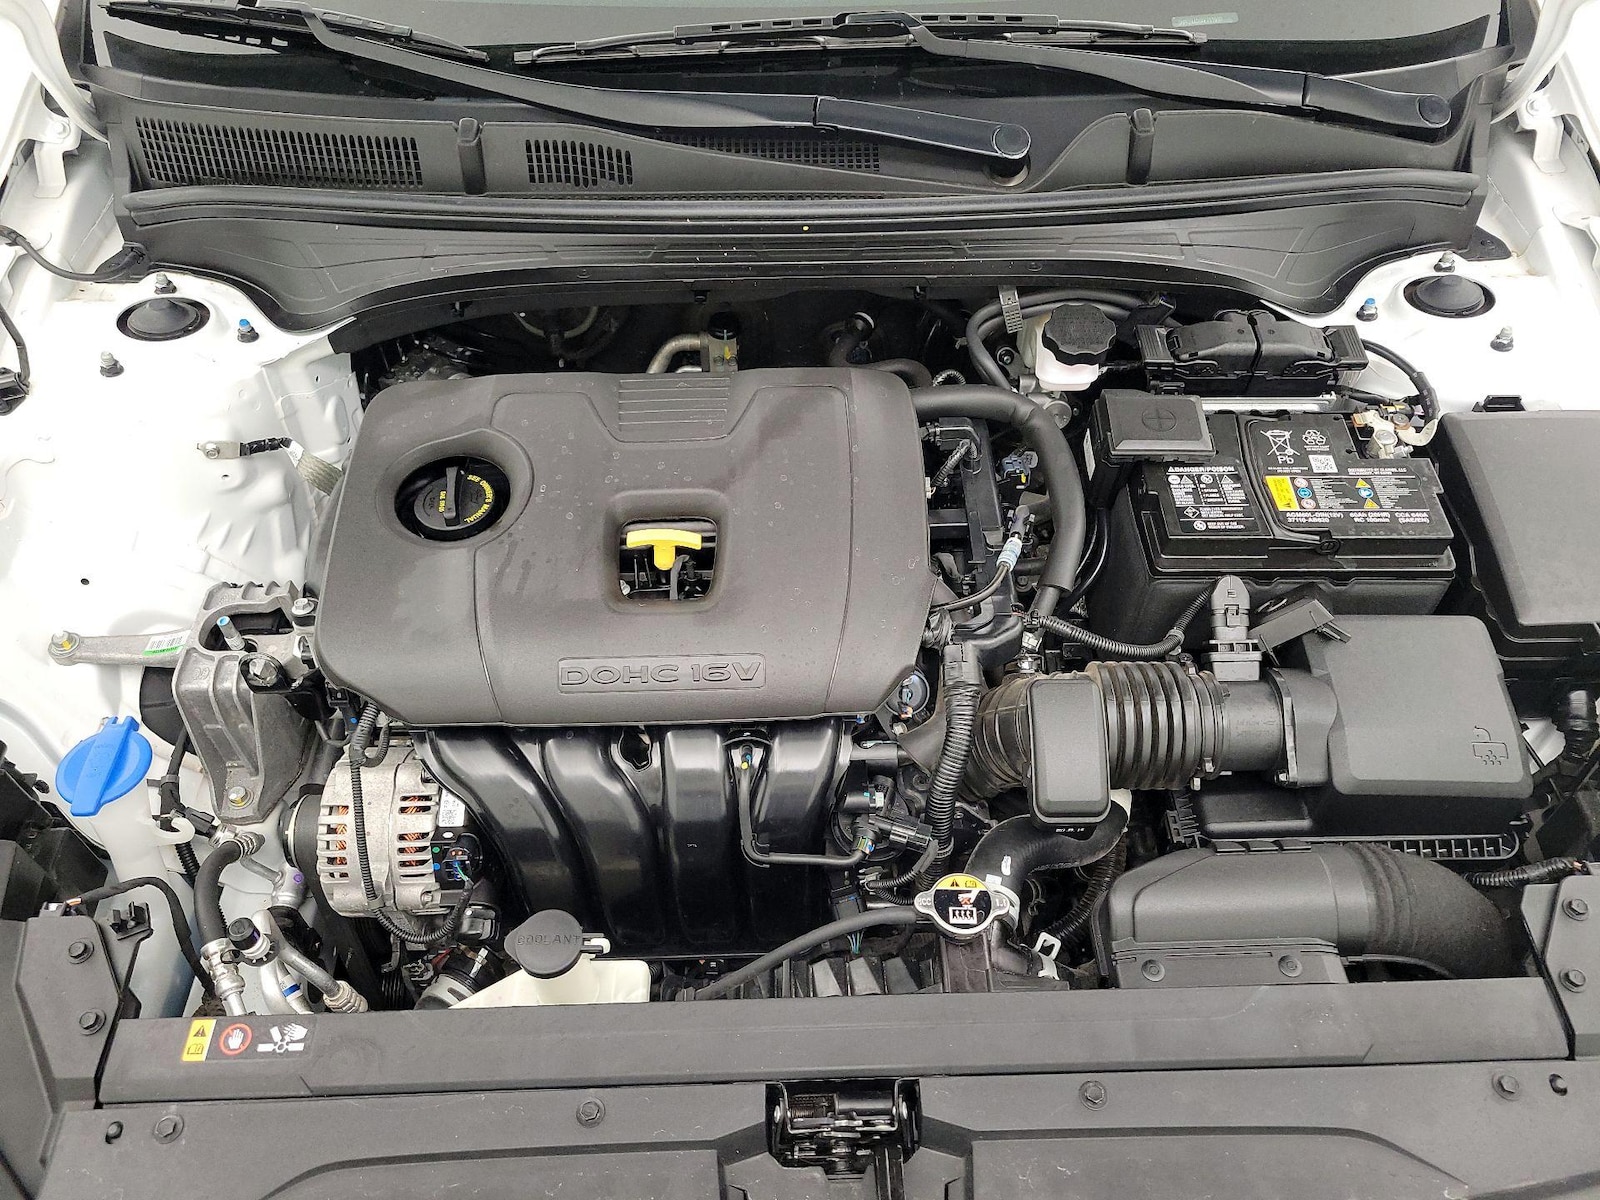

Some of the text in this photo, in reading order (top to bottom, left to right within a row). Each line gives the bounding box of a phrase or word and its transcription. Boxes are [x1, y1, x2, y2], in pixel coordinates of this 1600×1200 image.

[1277, 455, 1294, 464] Pb
[467, 474, 482, 482] SEE
[464, 503, 490, 523] MANUAL
[560, 662, 761, 685] DOHC 16V
[516, 934, 582, 946] COOLANT
